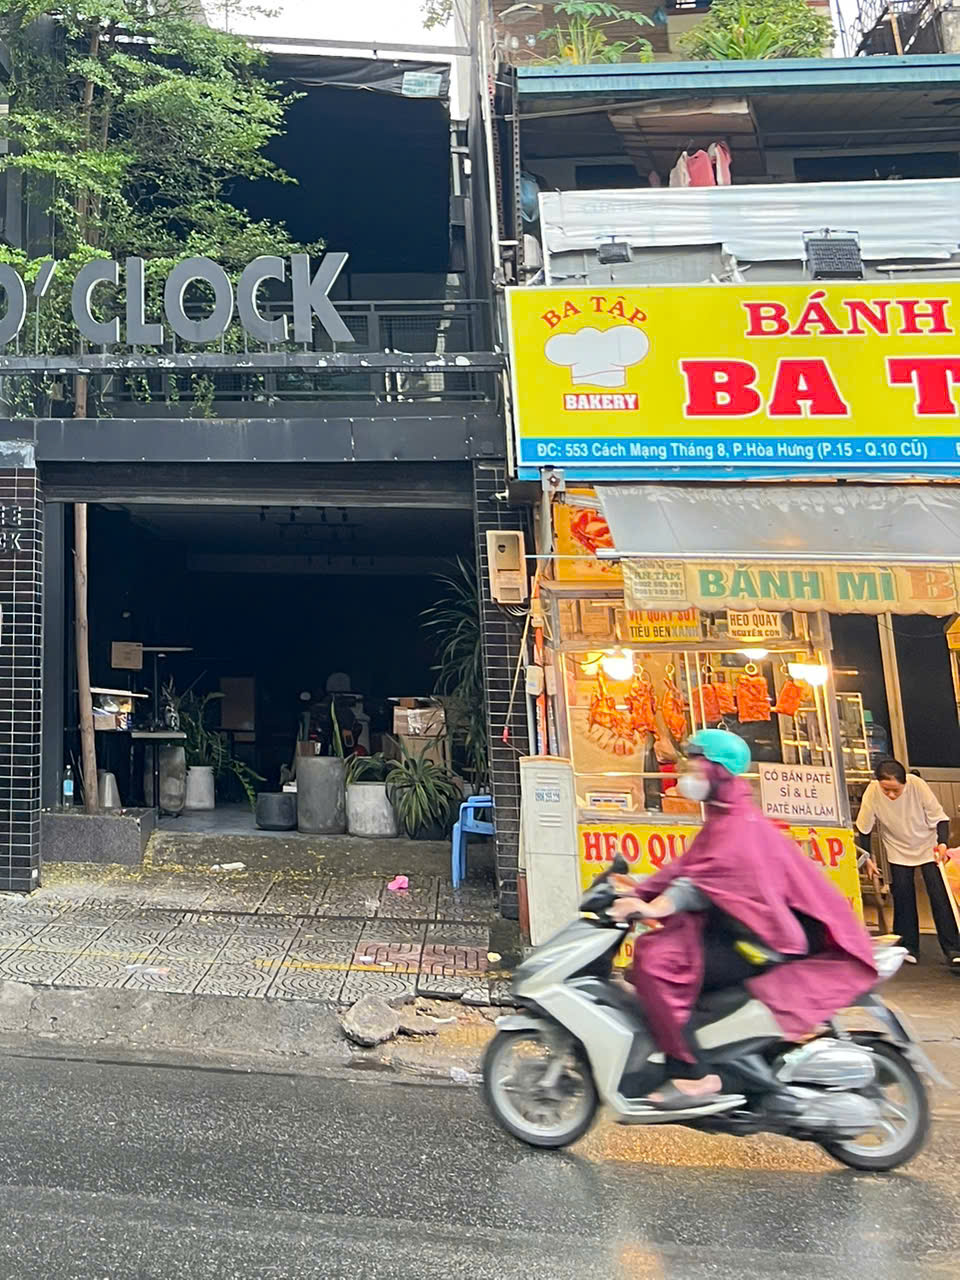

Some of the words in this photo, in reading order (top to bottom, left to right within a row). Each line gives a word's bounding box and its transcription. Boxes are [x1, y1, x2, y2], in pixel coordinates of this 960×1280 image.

[541, 300, 581, 328] BA
[589, 295, 647, 323] TẬP
[743, 290, 953, 336] BÁNH
[681, 359, 848, 416] BA
[565, 394, 637, 409] BAKERY
[538, 443, 561, 456] ĐC:
[565, 443, 588, 457] 553
[592, 442, 626, 457] Cách
[630, 442, 667, 460] Mạng
[671, 442, 713, 460] Tháng
[717, 443, 730, 458] 8,
[777, 442, 814, 460] Hưng
[817, 442, 852, 459] (P.15
[865, 442, 897, 457] Q.10
[900, 438, 927, 459] CŨ)
[699, 563, 822, 599] BÁNH
[837, 564, 895, 601] MÌ
[647, 610, 673, 623] QUAY
[729, 614, 749, 626] HEO
[753, 614, 778, 627] QUAY
[731, 628, 763, 637] NGUYÊN
[765, 629, 780, 637] CON
[764, 769, 778, 780] CÓ
[781, 769, 803, 782] BÁN
[794, 788, 801, 797] &
[792, 802, 812, 815] NHÀ
[583, 832, 639, 864] HEO
